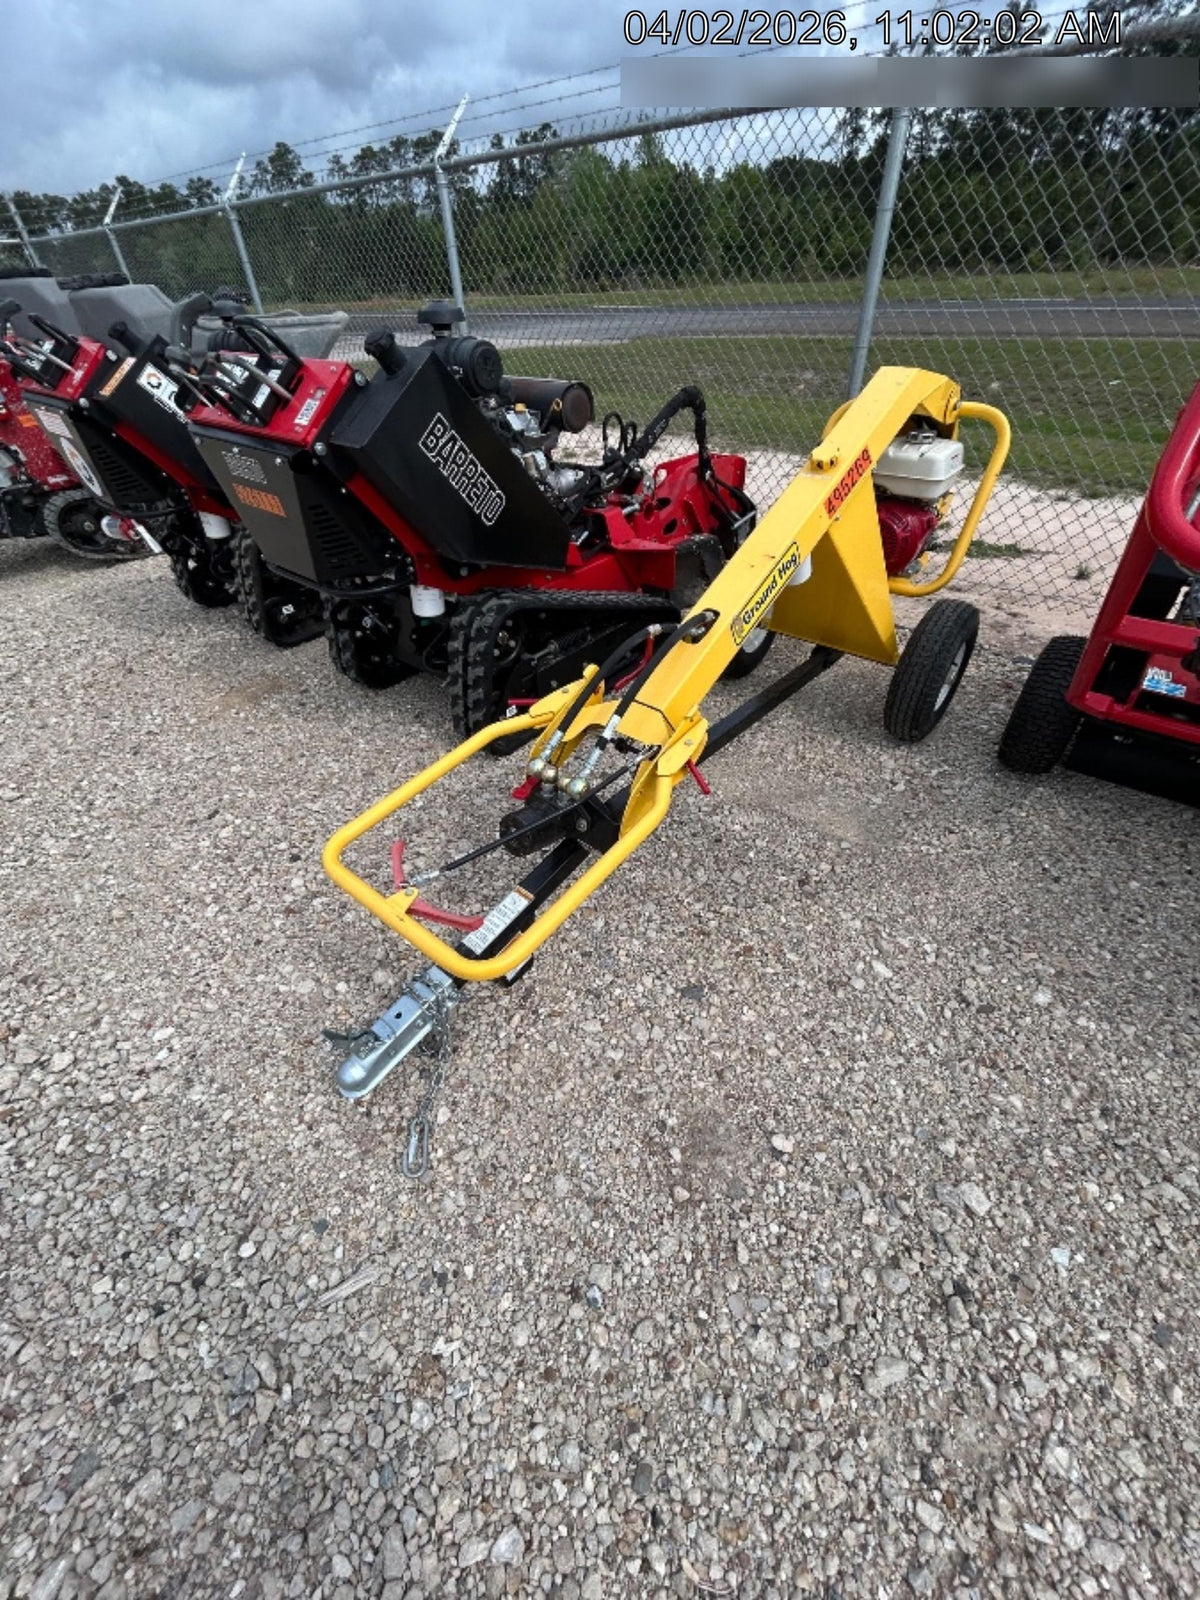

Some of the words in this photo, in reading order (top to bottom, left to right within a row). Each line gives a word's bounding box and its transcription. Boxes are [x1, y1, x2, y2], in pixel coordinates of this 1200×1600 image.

[419, 412, 506, 525] BARRETO
[827, 448, 872, 514] 495269
[743, 574, 778, 624] Ground
[778, 553, 797, 580] Hog
